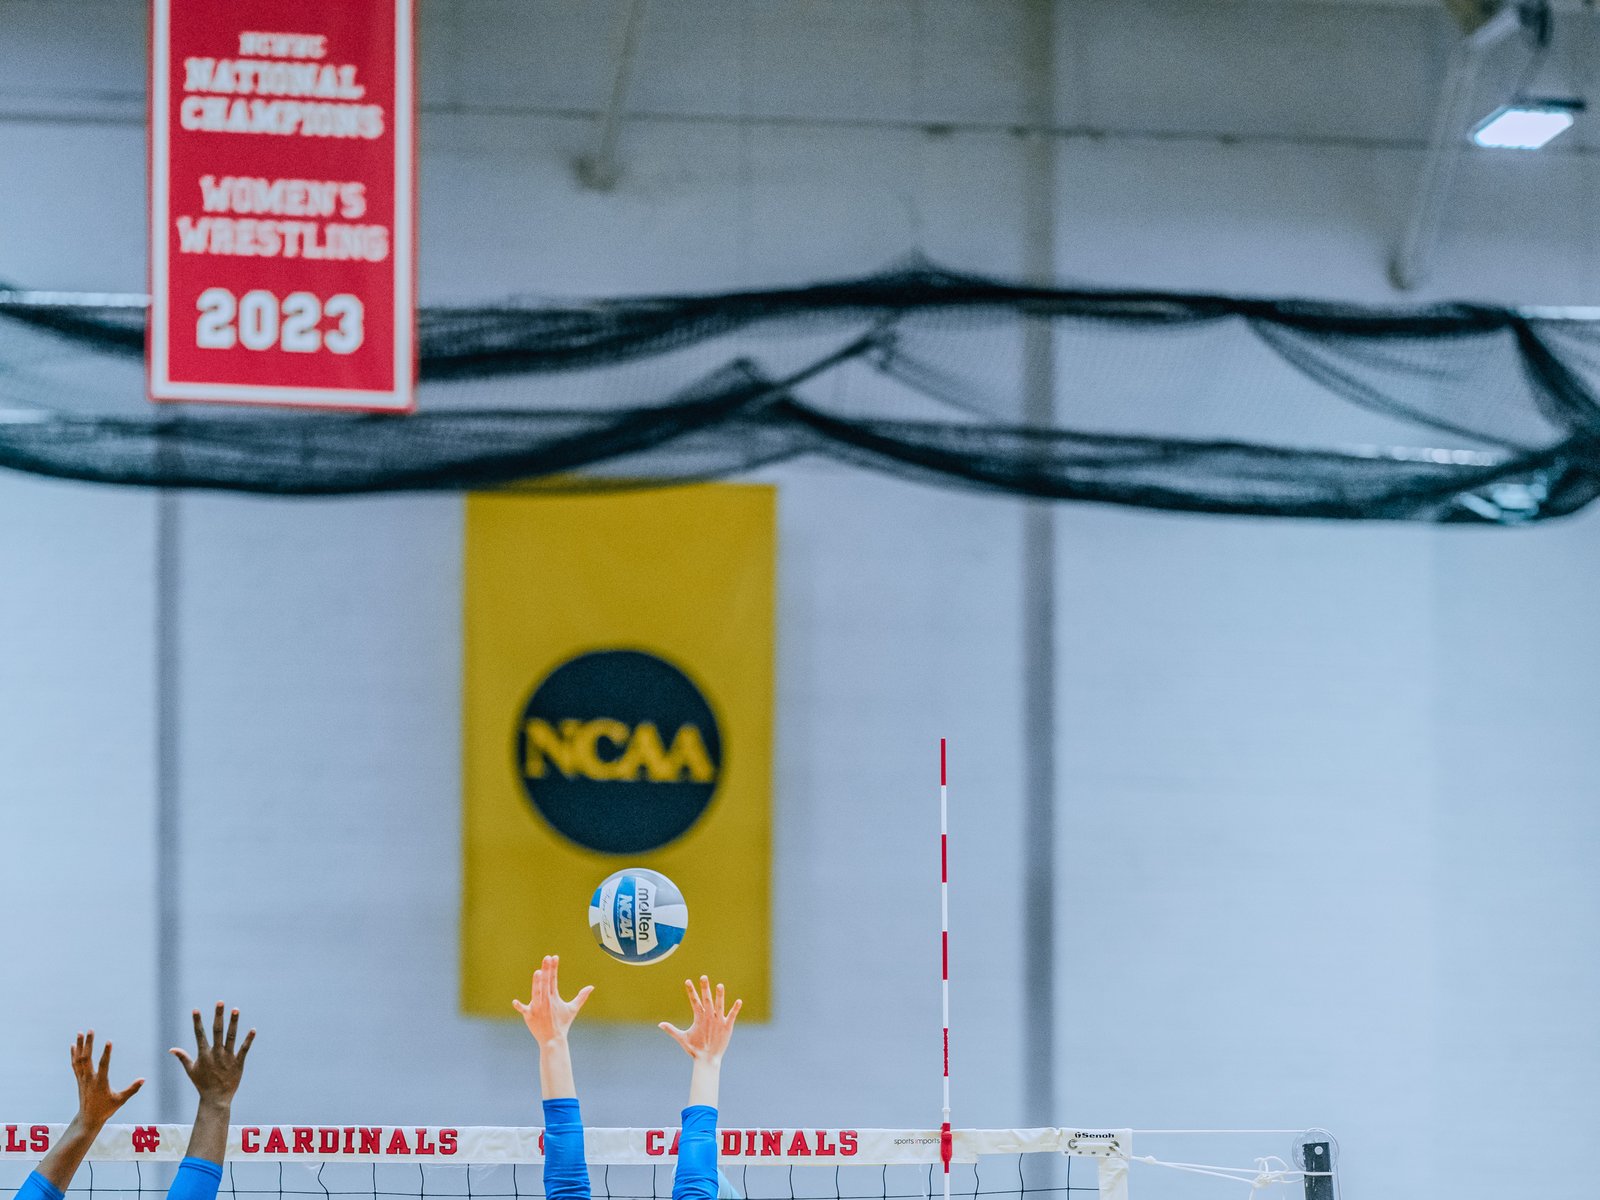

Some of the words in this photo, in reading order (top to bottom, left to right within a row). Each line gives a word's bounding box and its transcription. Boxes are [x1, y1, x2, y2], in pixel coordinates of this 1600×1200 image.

[182, 57, 366, 100] NATIONAL
[180, 96, 385, 139] CHAMPIONS
[199, 175, 367, 218] WOMEN'S
[176, 216, 389, 262] WRESTLING
[196, 288, 365, 354] 2023
[525, 718, 715, 783] NCAA
[638, 888, 652, 941] molten
[241, 1126, 458, 1155] CARDINALS
[646, 1129, 859, 1156] CDINALS
